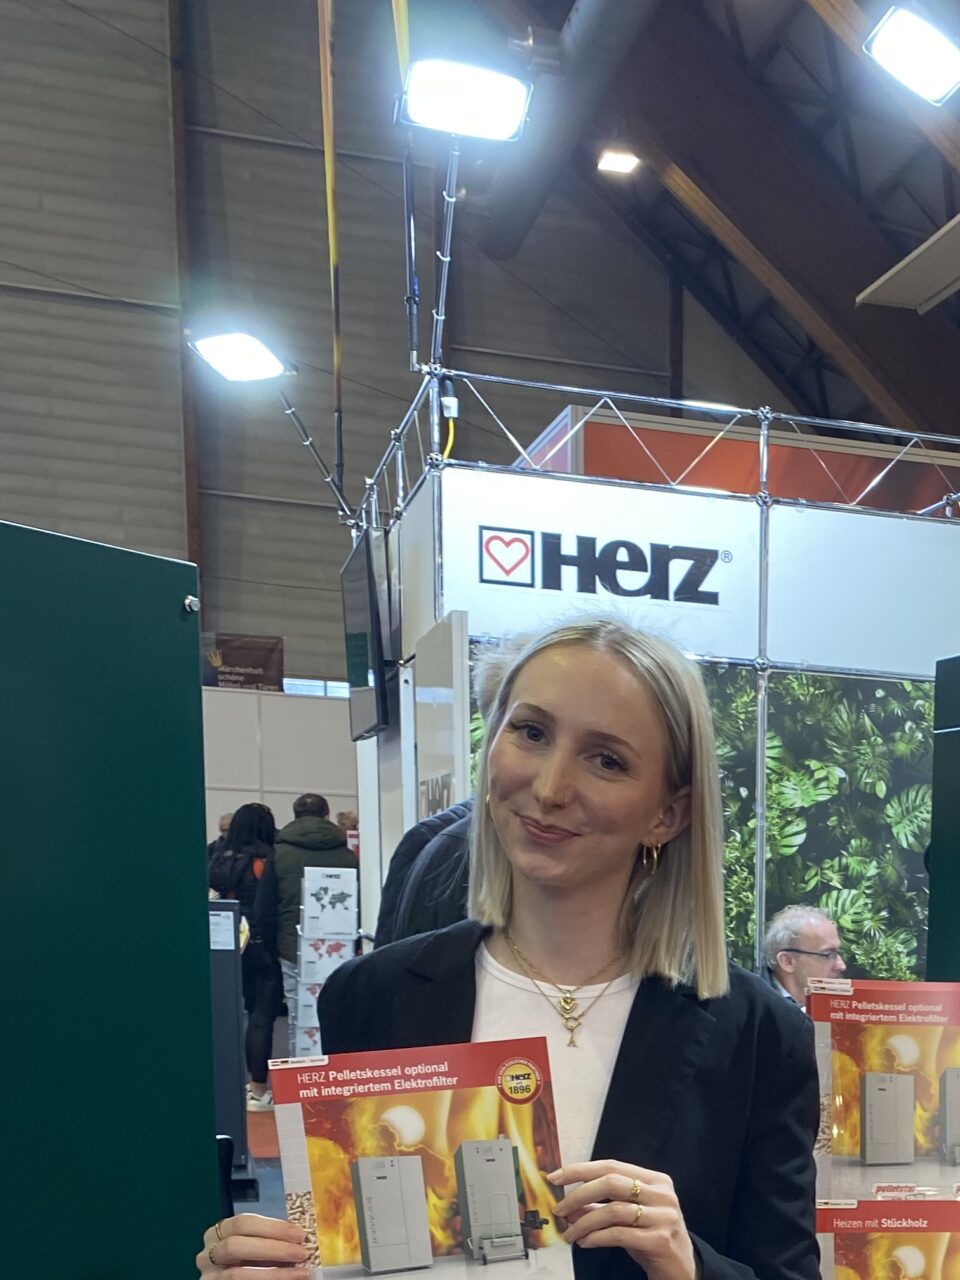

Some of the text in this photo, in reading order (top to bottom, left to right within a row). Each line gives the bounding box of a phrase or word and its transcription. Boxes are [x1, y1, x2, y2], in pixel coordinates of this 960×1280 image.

[830, 1000, 943, 1012] HERZ Pelletskessel optional
[845, 1012, 897, 1022] integriertem
[899, 1014, 949, 1023] Elektrofilter
[297, 1061, 448, 1085] HERZ Pelletskessel optional
[299, 1076, 459, 1098] mit integriertem Elektrofilter
[509, 1084, 532, 1094] 1896
[833, 1218, 928, 1228] Heizen mit Stückholz
